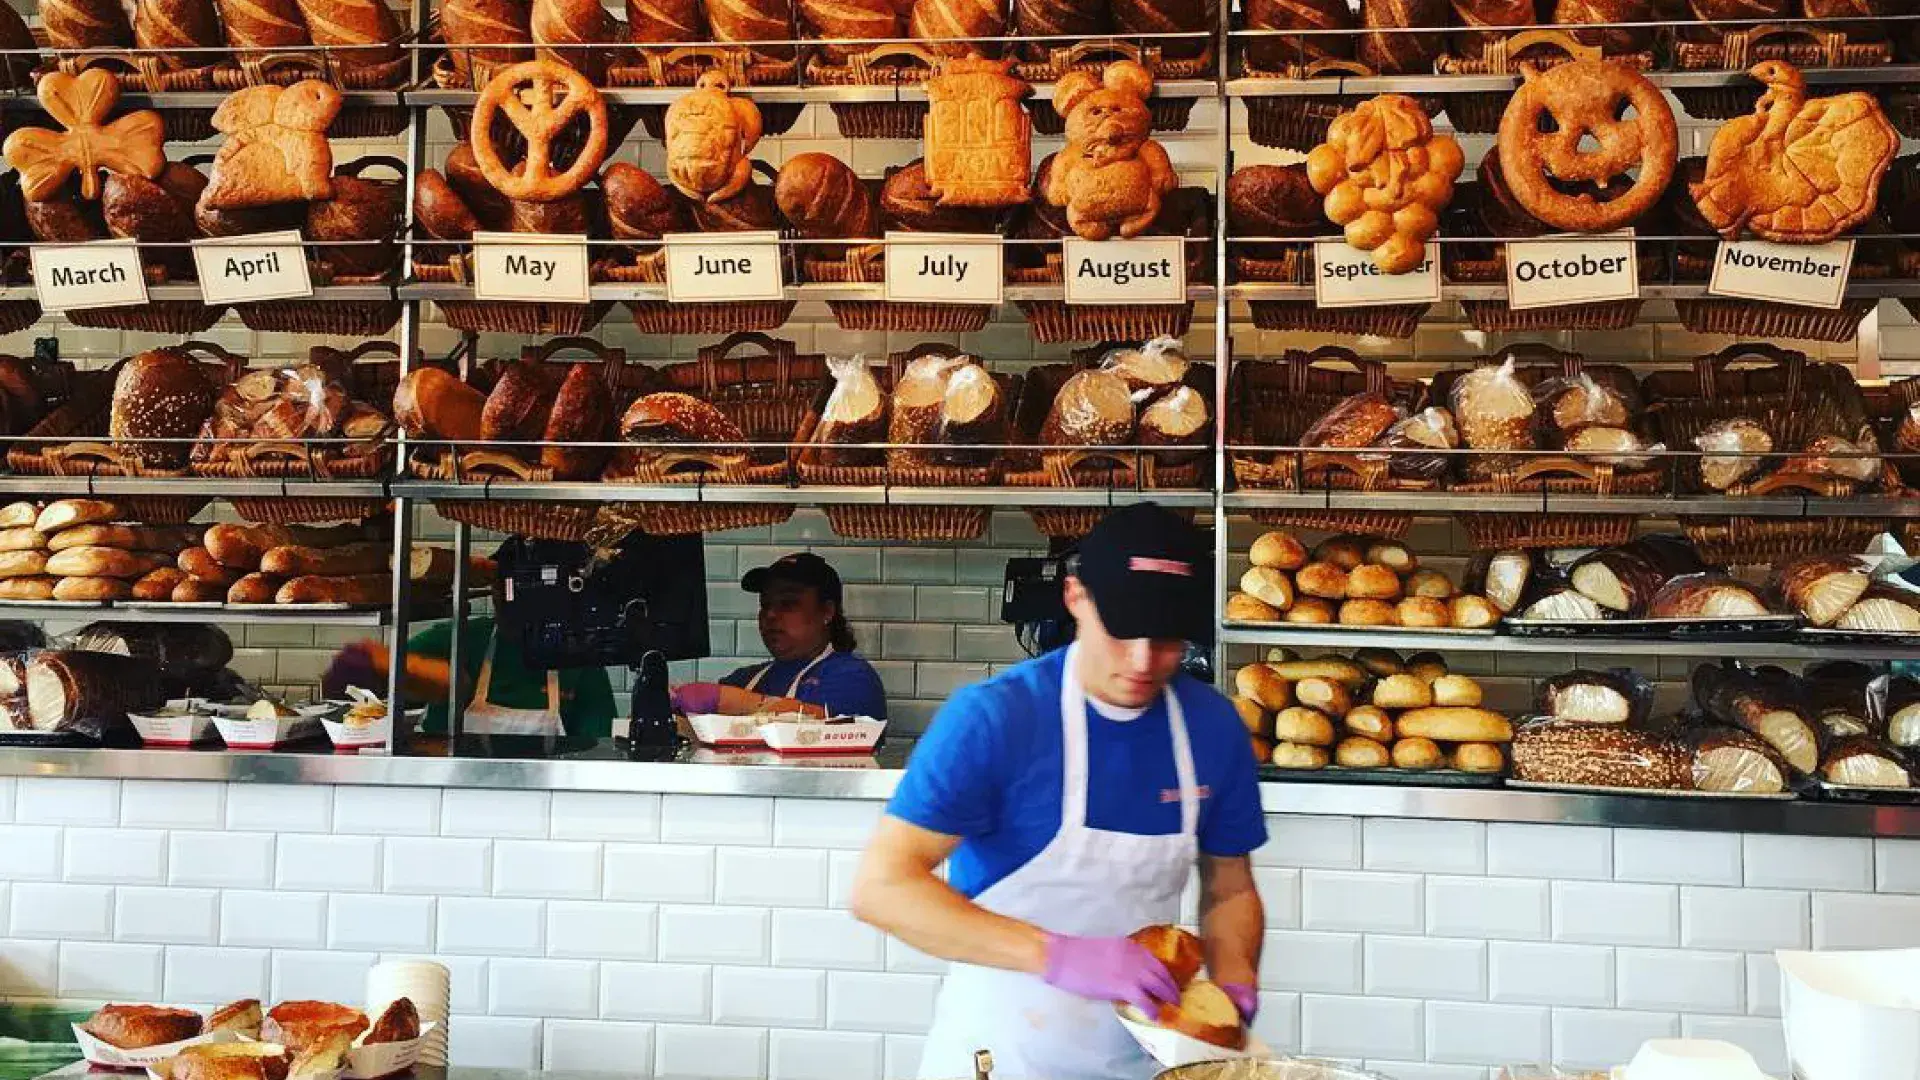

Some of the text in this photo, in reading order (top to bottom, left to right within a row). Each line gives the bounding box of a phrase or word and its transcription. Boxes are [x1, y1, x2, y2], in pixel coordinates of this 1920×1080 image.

[53, 262, 125, 287] March
[225, 252, 279, 281] April
[506, 255, 556, 281] May
[694, 255, 751, 276] June
[918, 255, 968, 282] July
[1078, 258, 1171, 284] August
[1323, 260, 1434, 281] Septeer
[1515, 253, 1627, 282] October
[1724, 248, 1840, 278] November
